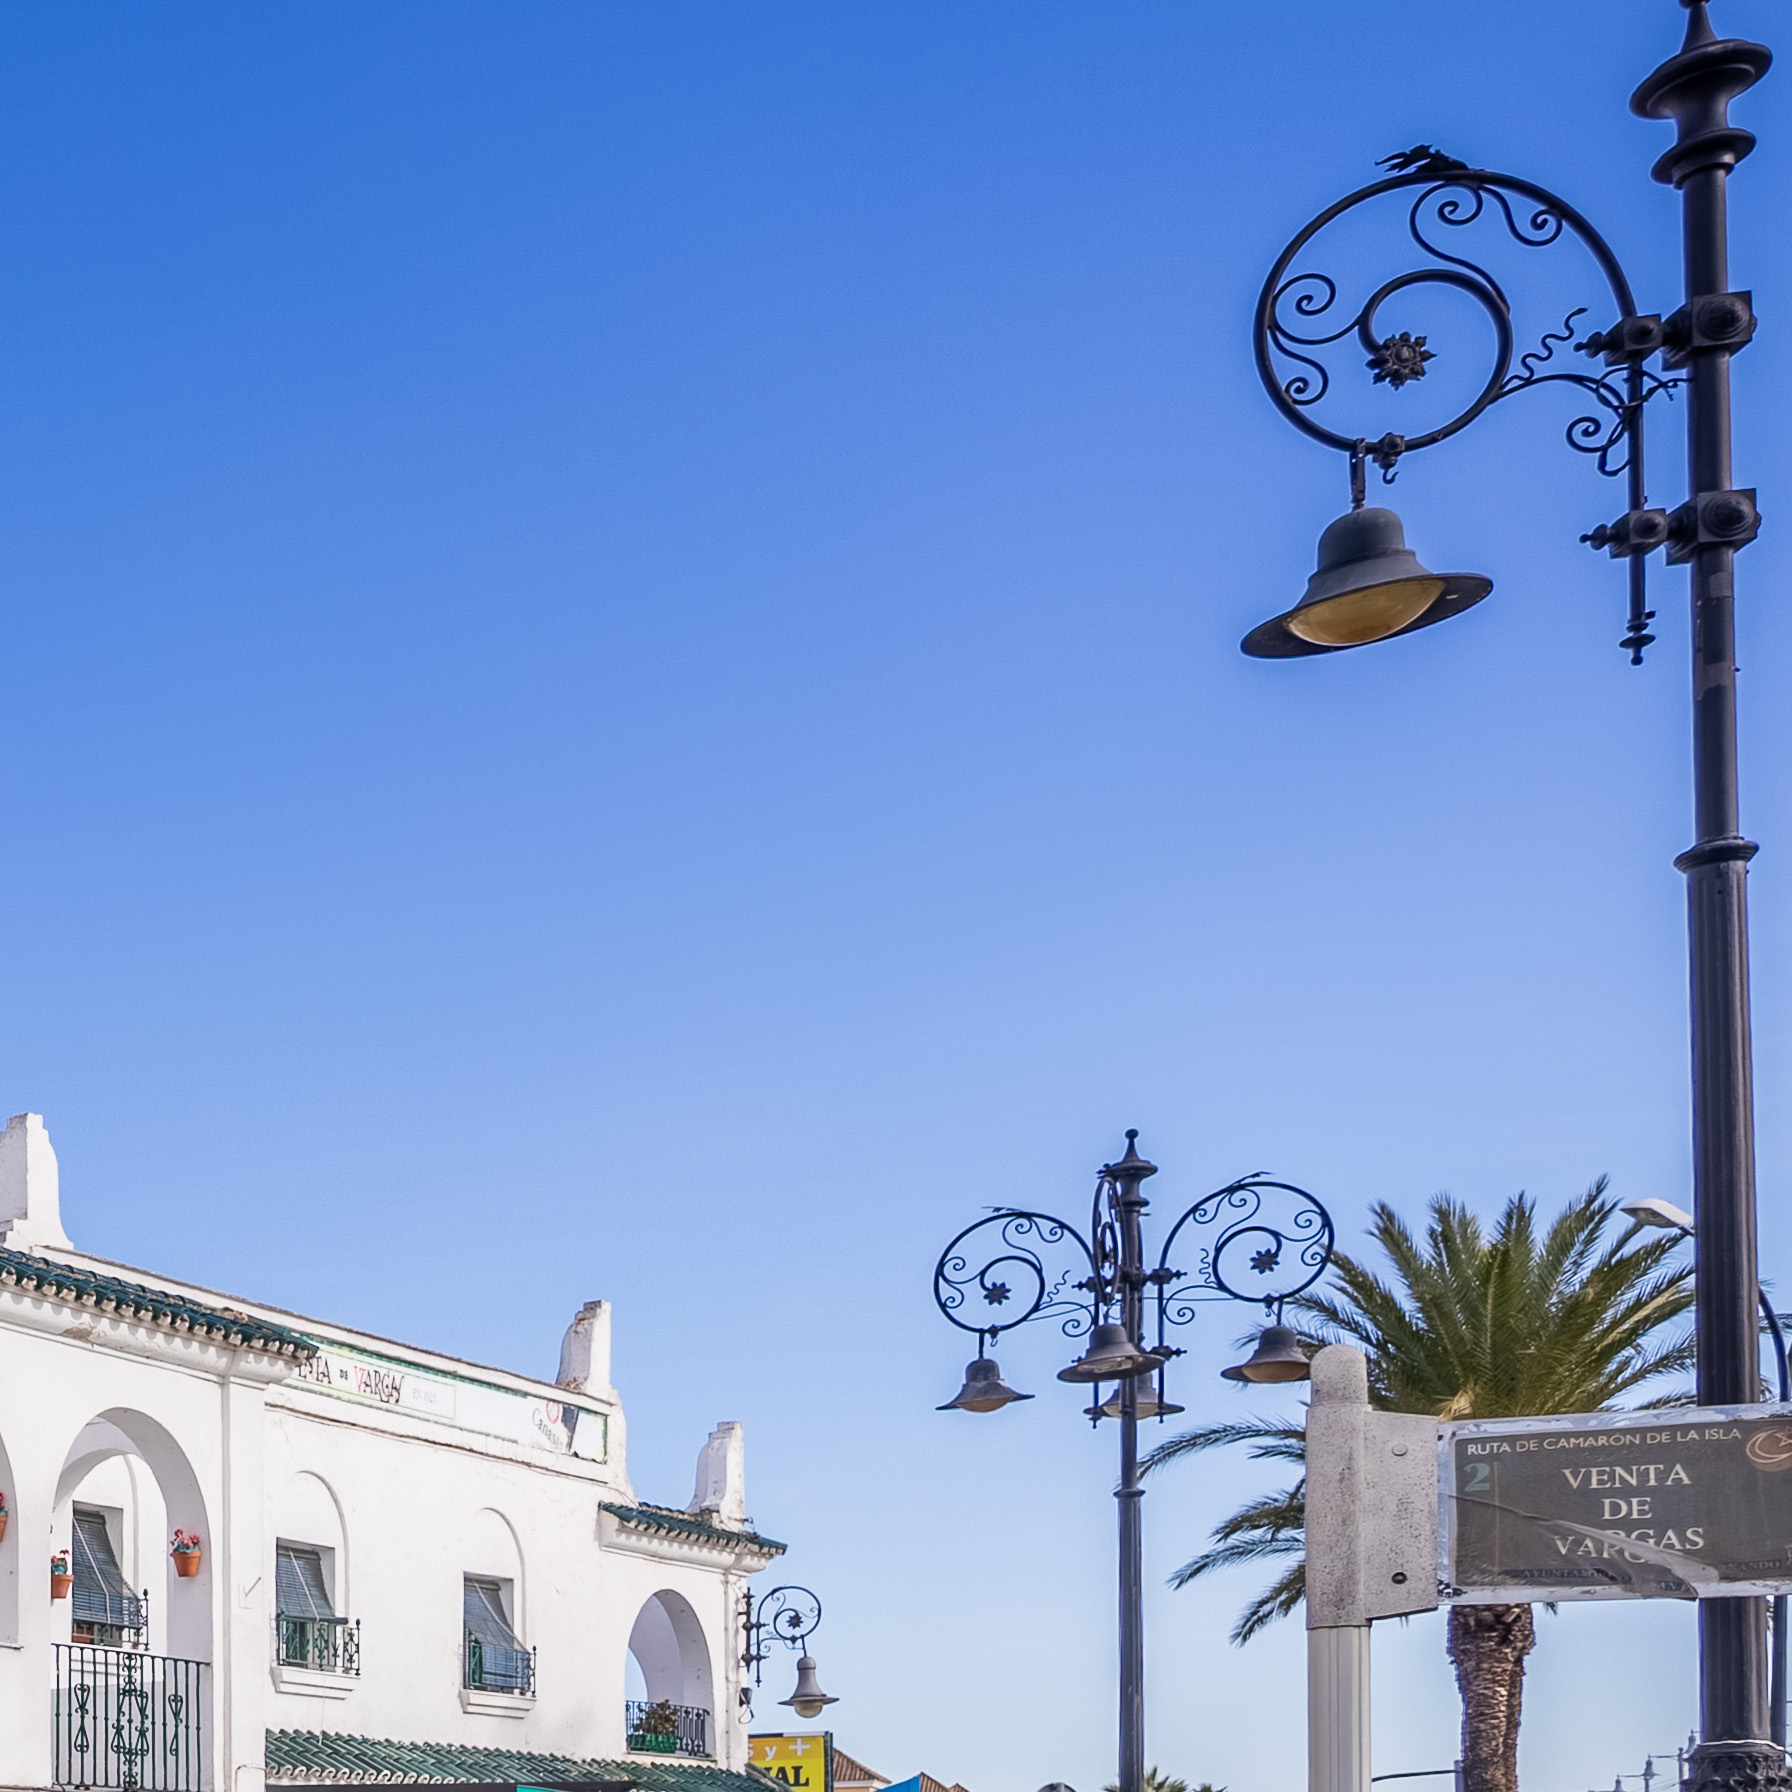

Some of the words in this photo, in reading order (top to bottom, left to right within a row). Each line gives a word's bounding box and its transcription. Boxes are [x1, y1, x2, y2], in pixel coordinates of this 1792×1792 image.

[1467, 1441, 1511, 1456] RUTA
[1517, 1439, 1539, 1452] DE
[1543, 1432, 1640, 1451] CAMARÓN
[1646, 1431, 1671, 1444] DE
[1677, 1429, 1699, 1442] LA
[1705, 1428, 1742, 1441] ISLA
[1464, 1462, 1491, 1492] 2
[1562, 1463, 1692, 1490] VENTA
[1601, 1497, 1653, 1521] DE
